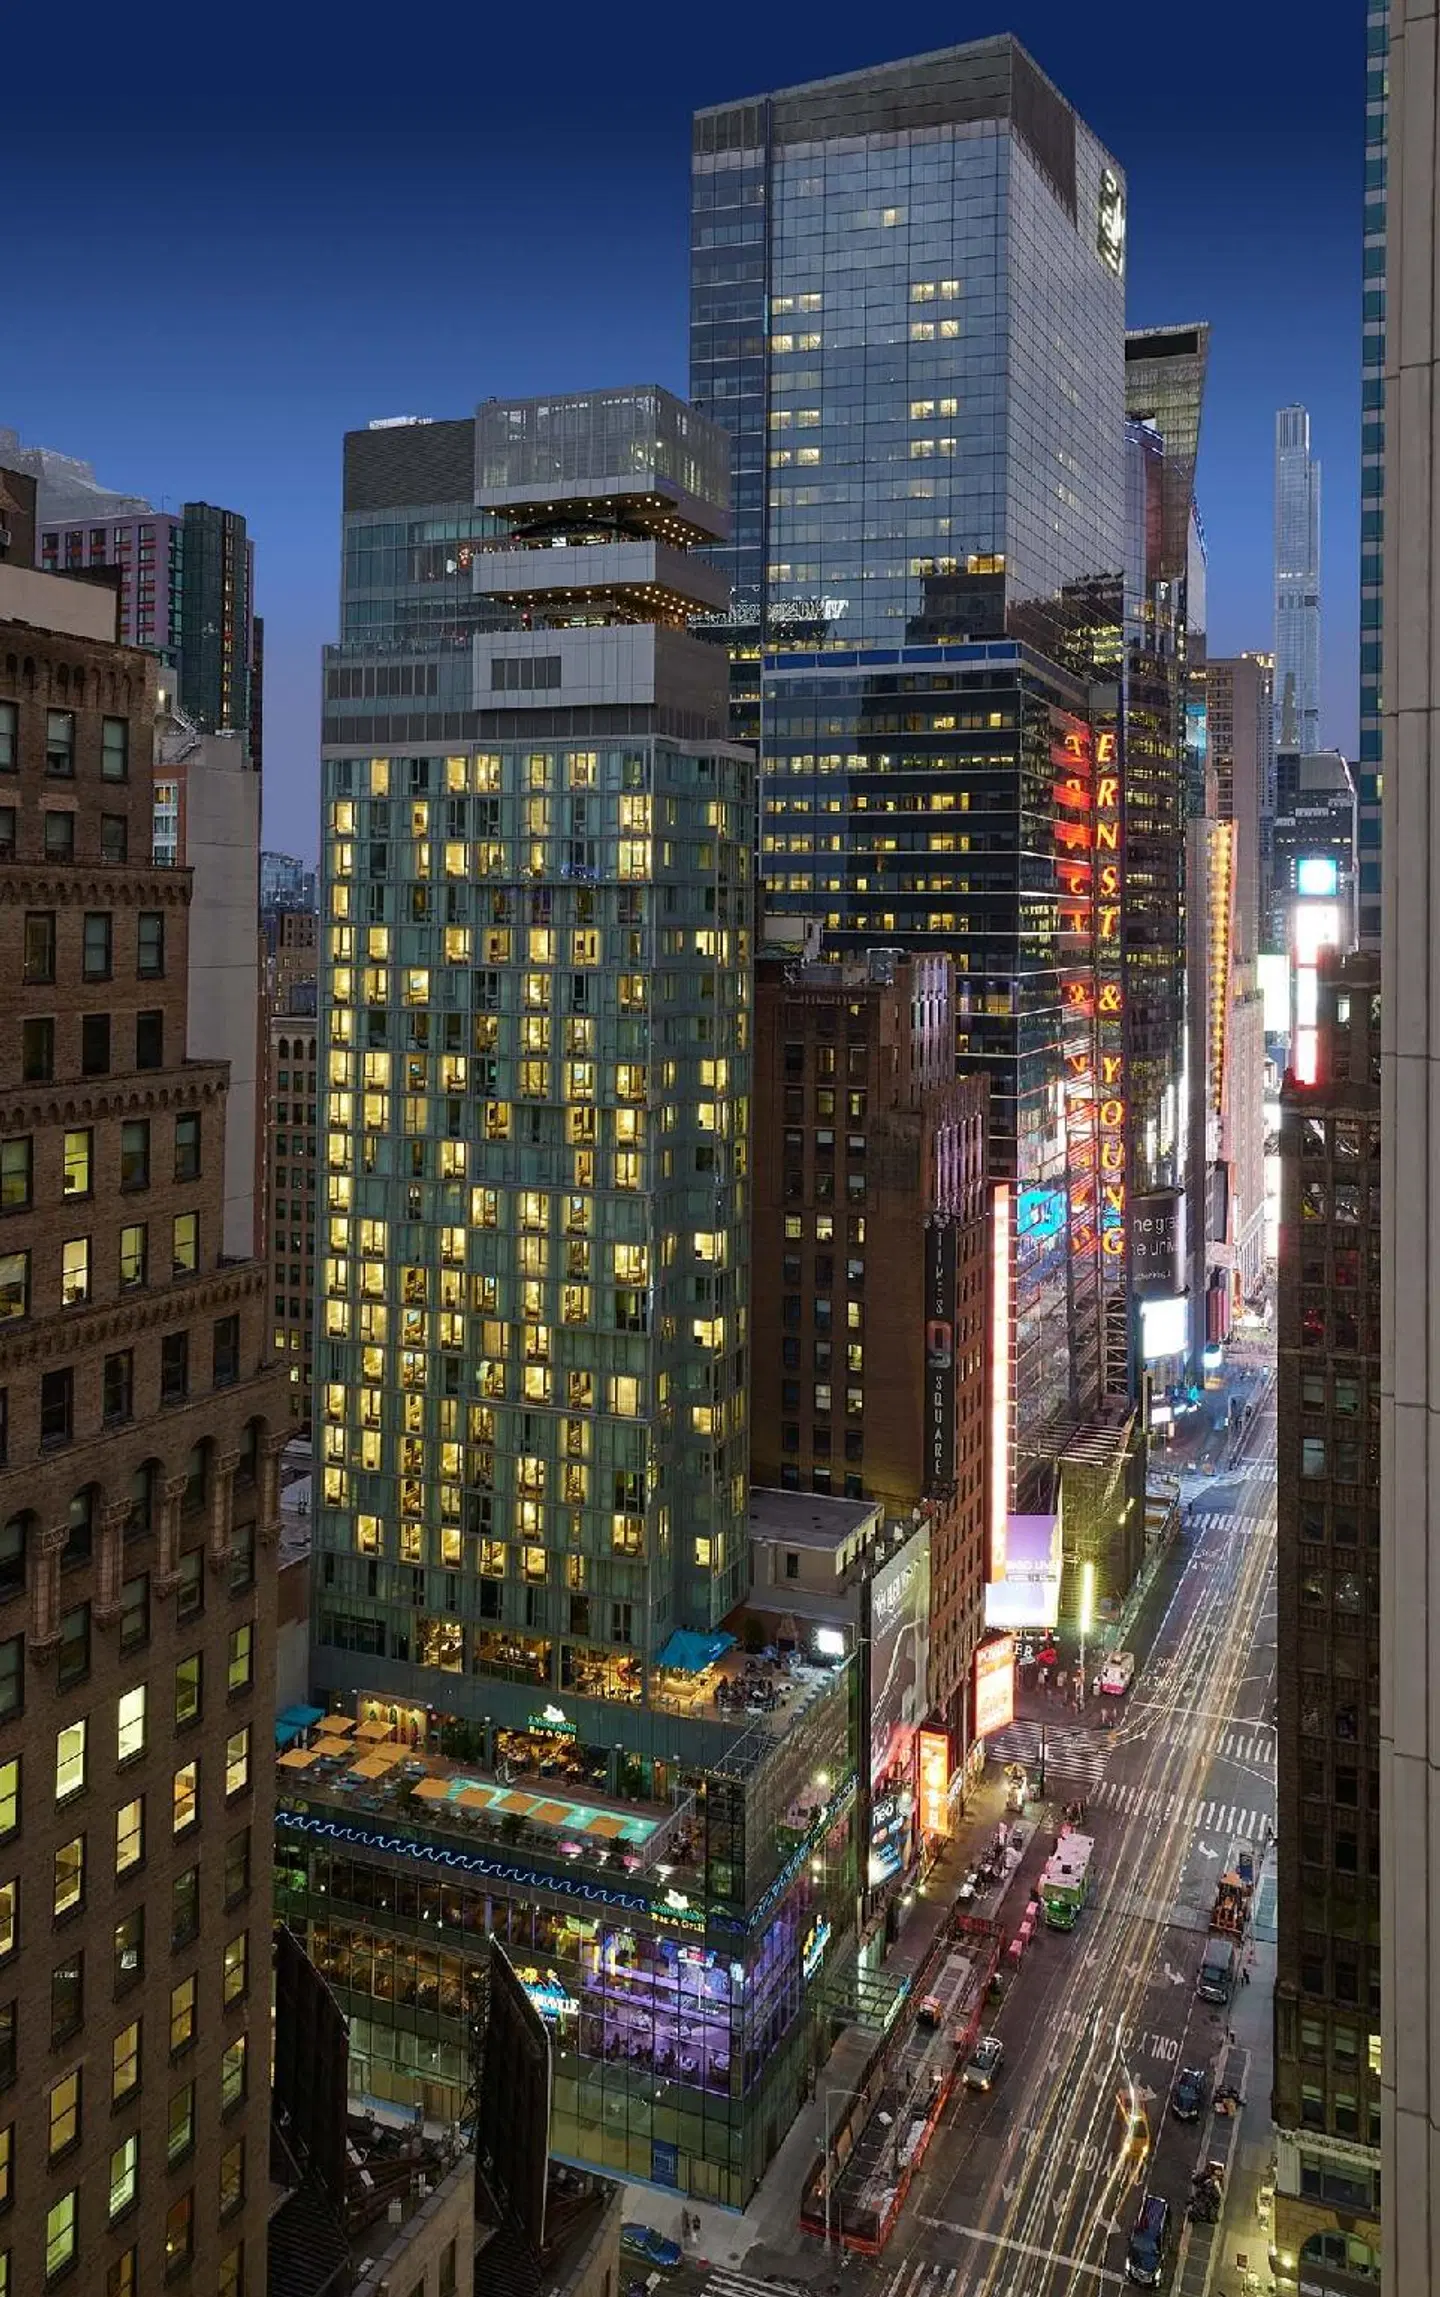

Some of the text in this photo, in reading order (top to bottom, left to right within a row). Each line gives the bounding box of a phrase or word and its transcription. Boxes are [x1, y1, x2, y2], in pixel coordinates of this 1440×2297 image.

[1097, 735, 1124, 1255] ERNST & YOUNG
[934, 1376, 942, 1474] SQUARE
[1137, 2031, 1178, 2062] ONLY
